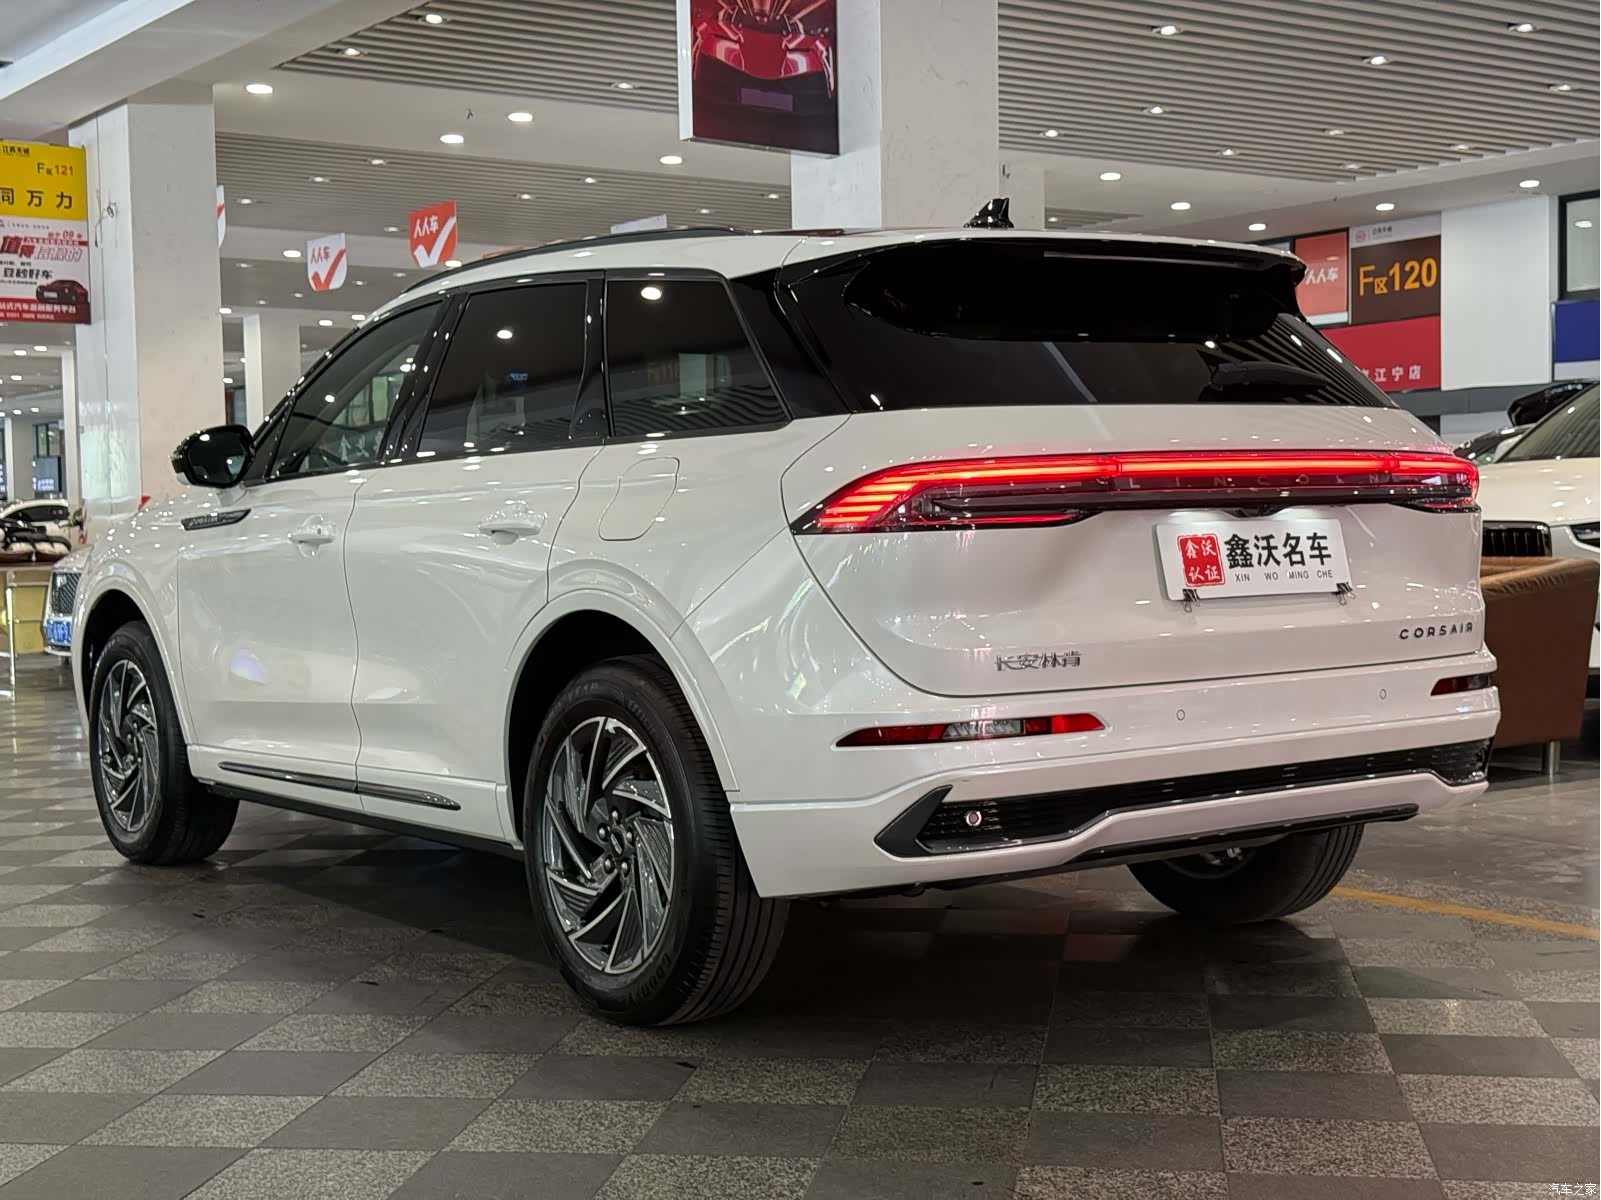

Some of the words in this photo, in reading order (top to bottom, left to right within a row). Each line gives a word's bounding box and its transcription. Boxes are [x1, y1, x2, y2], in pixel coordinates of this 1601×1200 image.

[413, 215, 439, 238] 人人车
[311, 246, 330, 264] 人人车
[1305, 266, 1339, 285] 人人车
[1359, 258, 1438, 296] F区120
[1224, 532, 1332, 569] 鑫沃名车
[1188, 564, 1221, 582] 认证
[1235, 573, 1250, 582] XIN
[1264, 571, 1279, 581] WO
[1288, 569, 1310, 580] MING
[1316, 569, 1333, 579] CHE
[1399, 621, 1473, 640] CORSAIR
[994, 650, 1082, 671] 长安林肯
